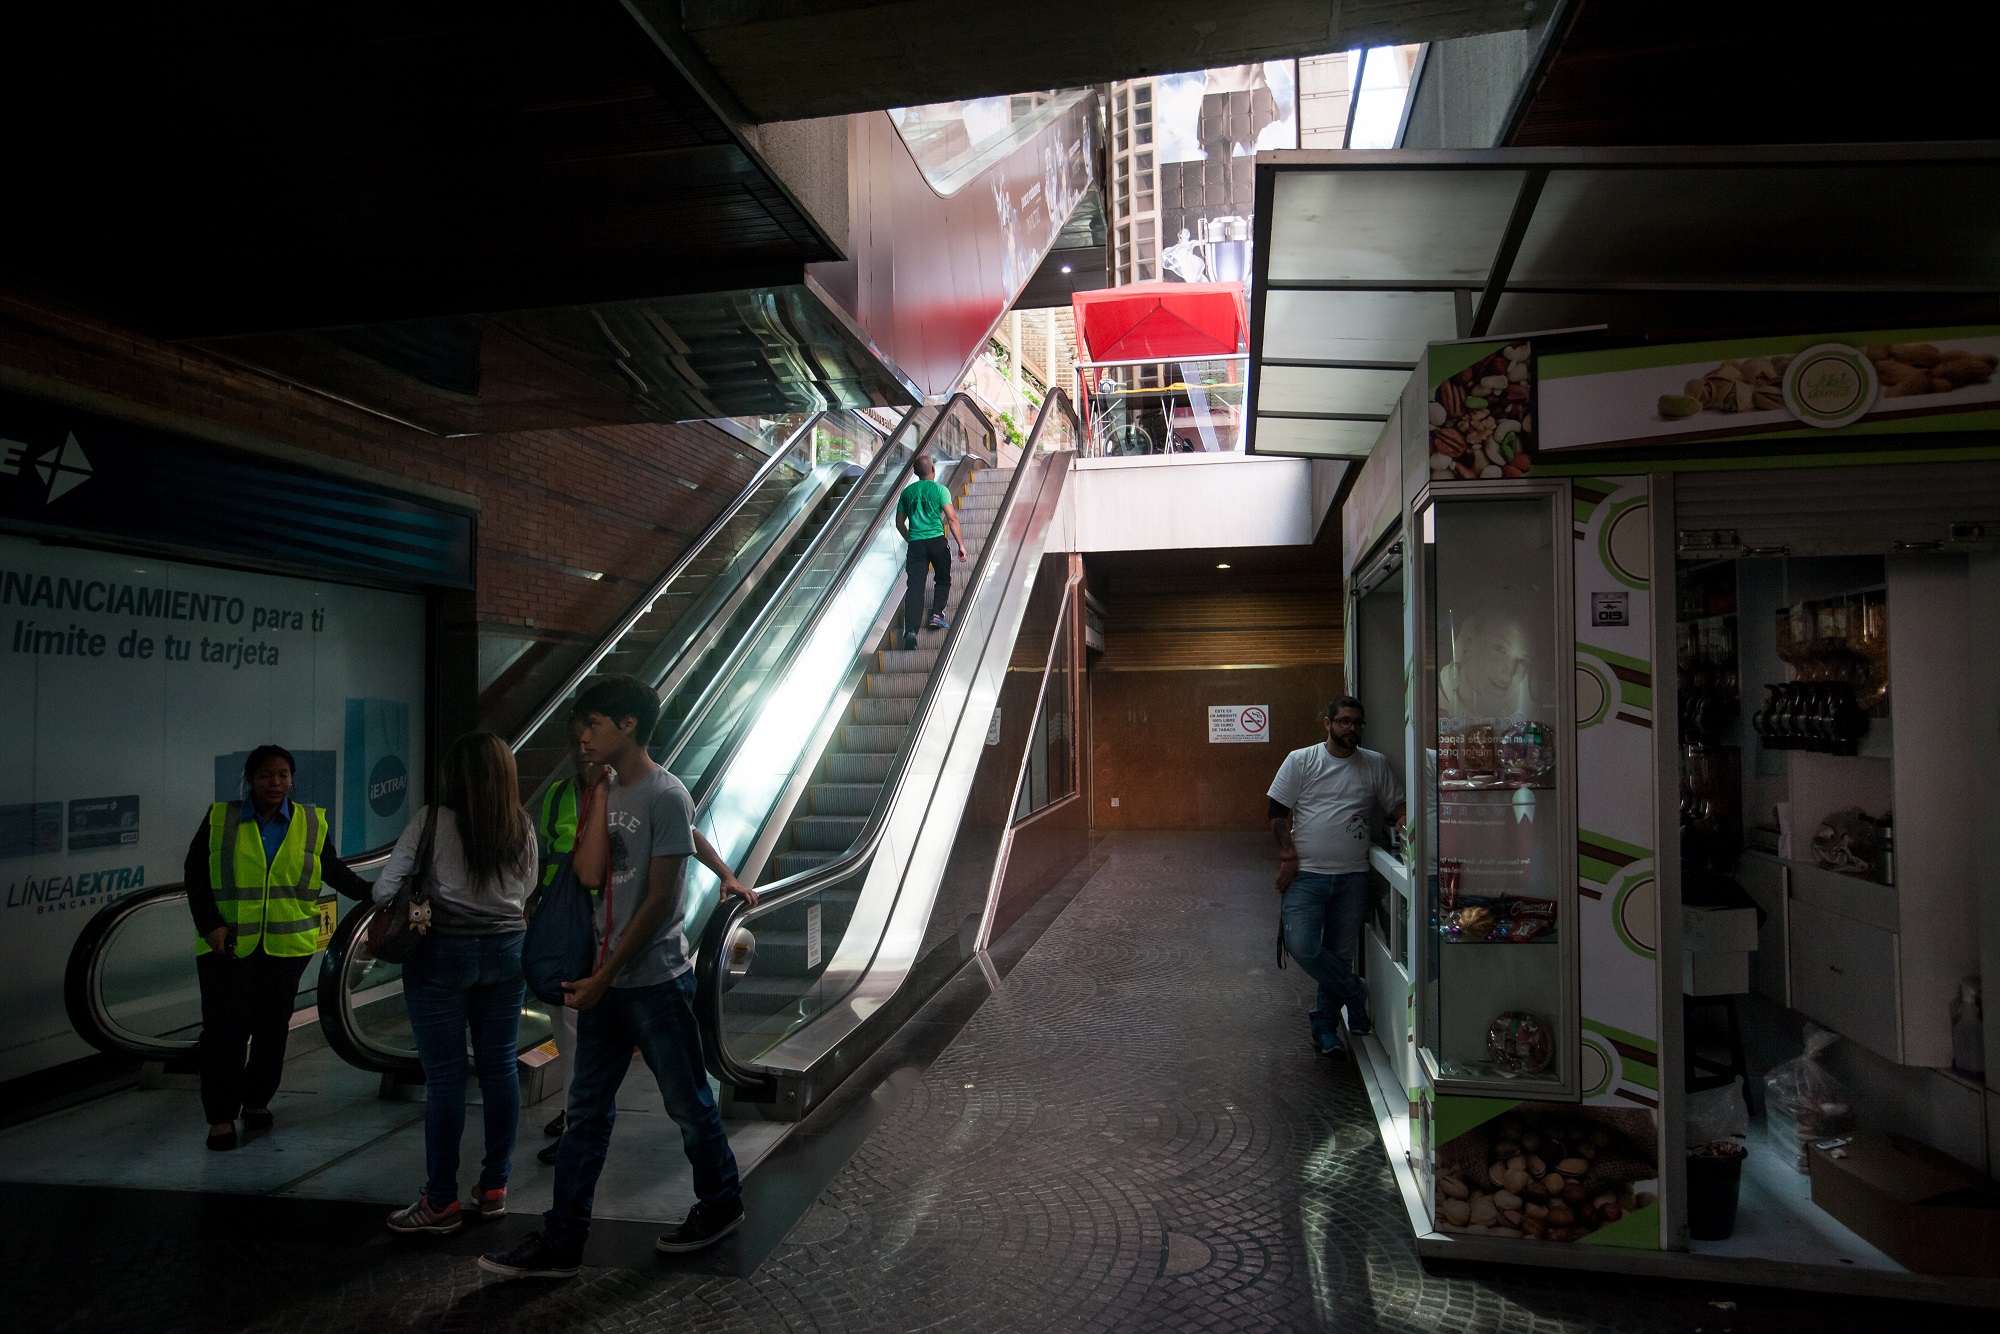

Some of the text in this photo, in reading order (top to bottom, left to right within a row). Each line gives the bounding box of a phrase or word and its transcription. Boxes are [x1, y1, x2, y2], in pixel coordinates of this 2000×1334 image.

[0, 569, 325, 632] NANCIAMIENTO para ti
[13, 620, 279, 670] límite de tu tarjeta
[370, 775, 407, 800] ¡EXTRA!
[608, 811, 642, 833] IKE
